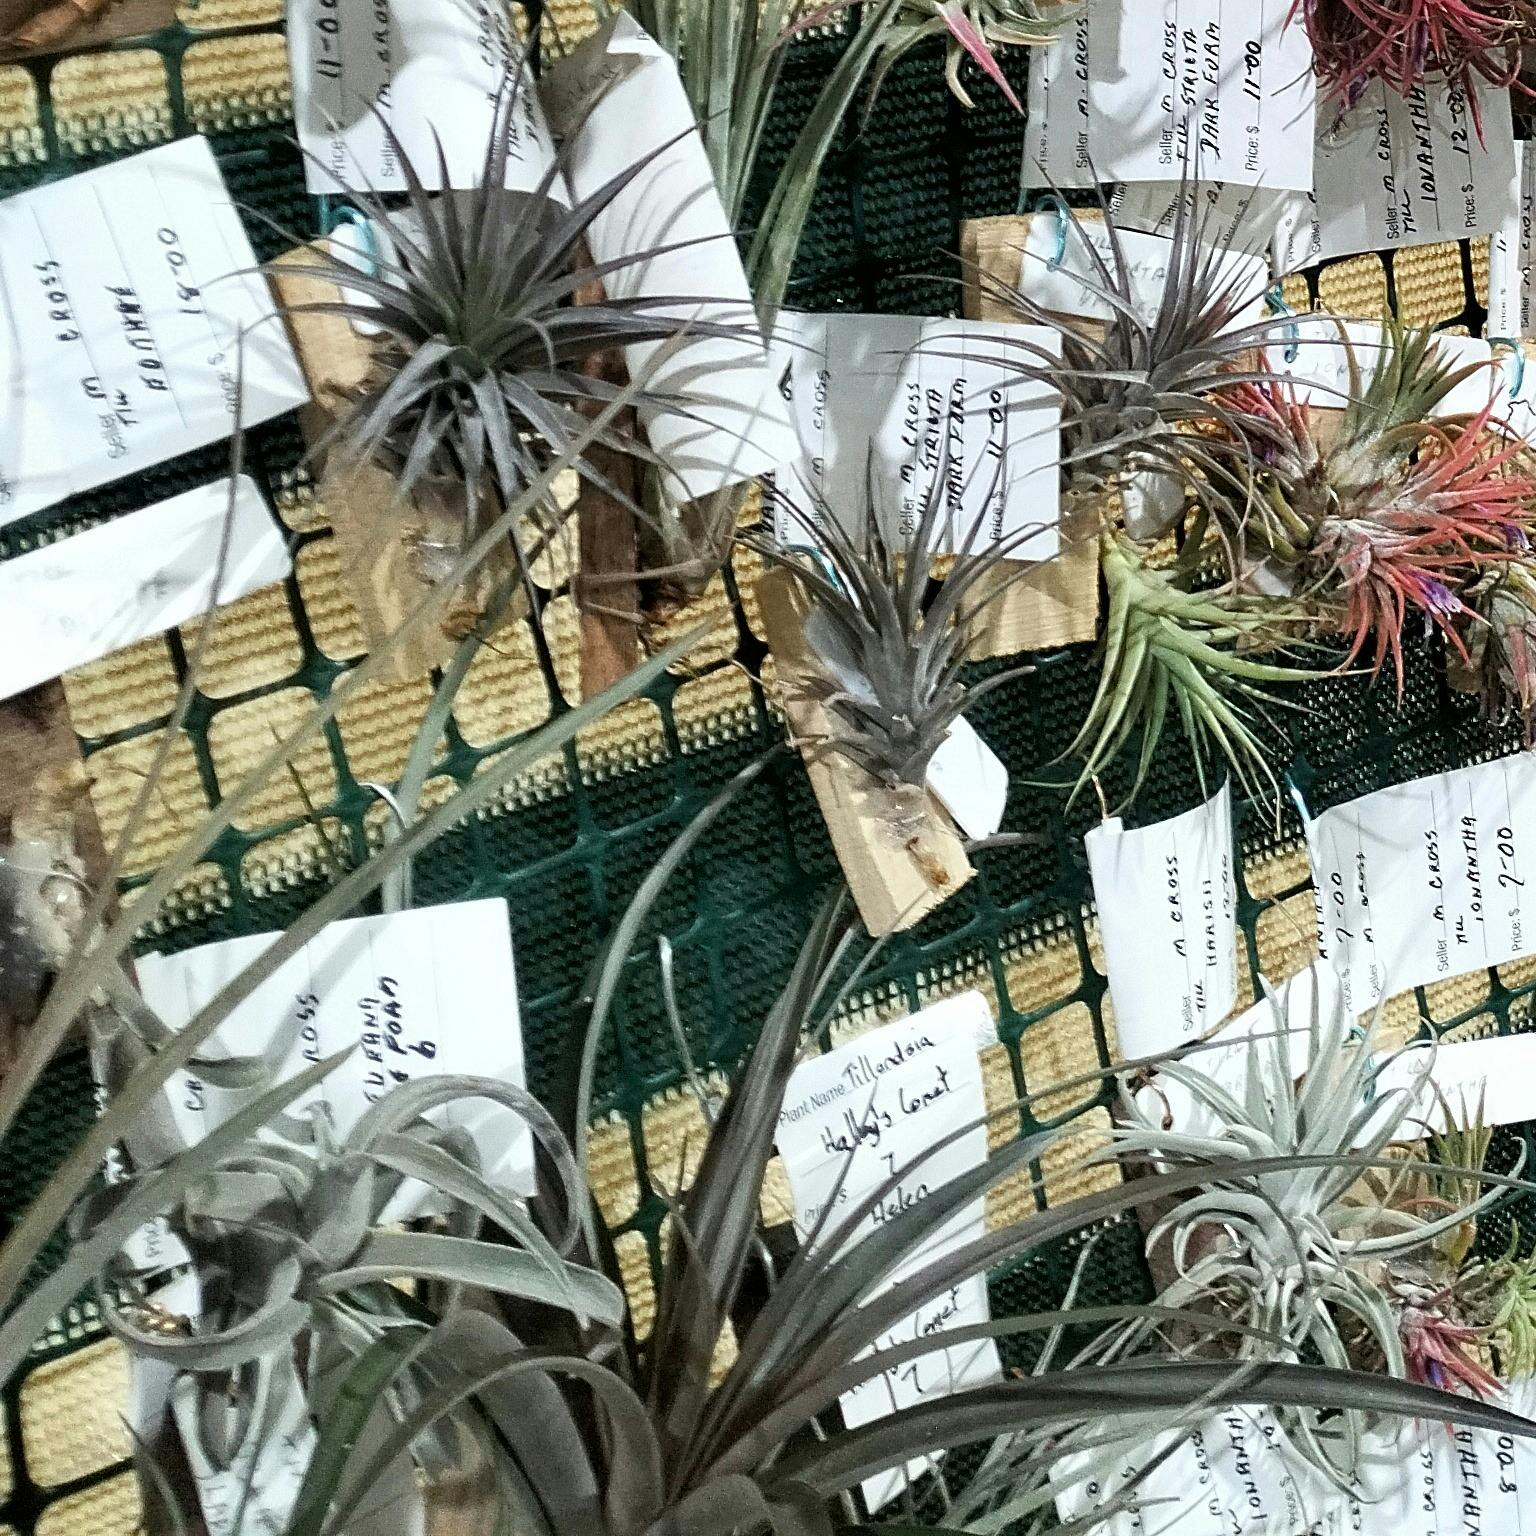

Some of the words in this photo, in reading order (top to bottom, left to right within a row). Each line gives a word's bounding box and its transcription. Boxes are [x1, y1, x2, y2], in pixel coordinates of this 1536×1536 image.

[1076, 18, 1088, 80] CROSS
[1163, 21, 1176, 79] CROSS
[1243, 40, 1261, 100] 11-00
[1161, 95, 1171, 112] M
[1076, 132, 1088, 168] Seller
[1159, 129, 1172, 164] Seller
[1200, 98, 1220, 159] DARK
[1246, 126, 1259, 134] $
[1377, 109, 1390, 160] CROSS
[1245, 137, 1258, 171] Price:
[1384, 175, 1394, 192] M
[1386, 205, 1399, 239] Seller
[1464, 196, 1476, 227] Price:
[32, 261, 80, 340] CROSS
[1521, 297, 1529, 328] Seller
[813, 370, 830, 429] CROSS
[901, 383, 920, 446] CROSS
[988, 391, 1003, 457] 11-00
[900, 465, 915, 483] M
[900, 496, 914, 535] Seller
[1426, 830, 1443, 888] CROSS
[1496, 827, 1524, 887] 7-00
[1165, 856, 1181, 923] CROSS
[1434, 938, 1448, 971] Seller
[1509, 920, 1522, 952] Price:
[295, 994, 319, 1061] ROSS
